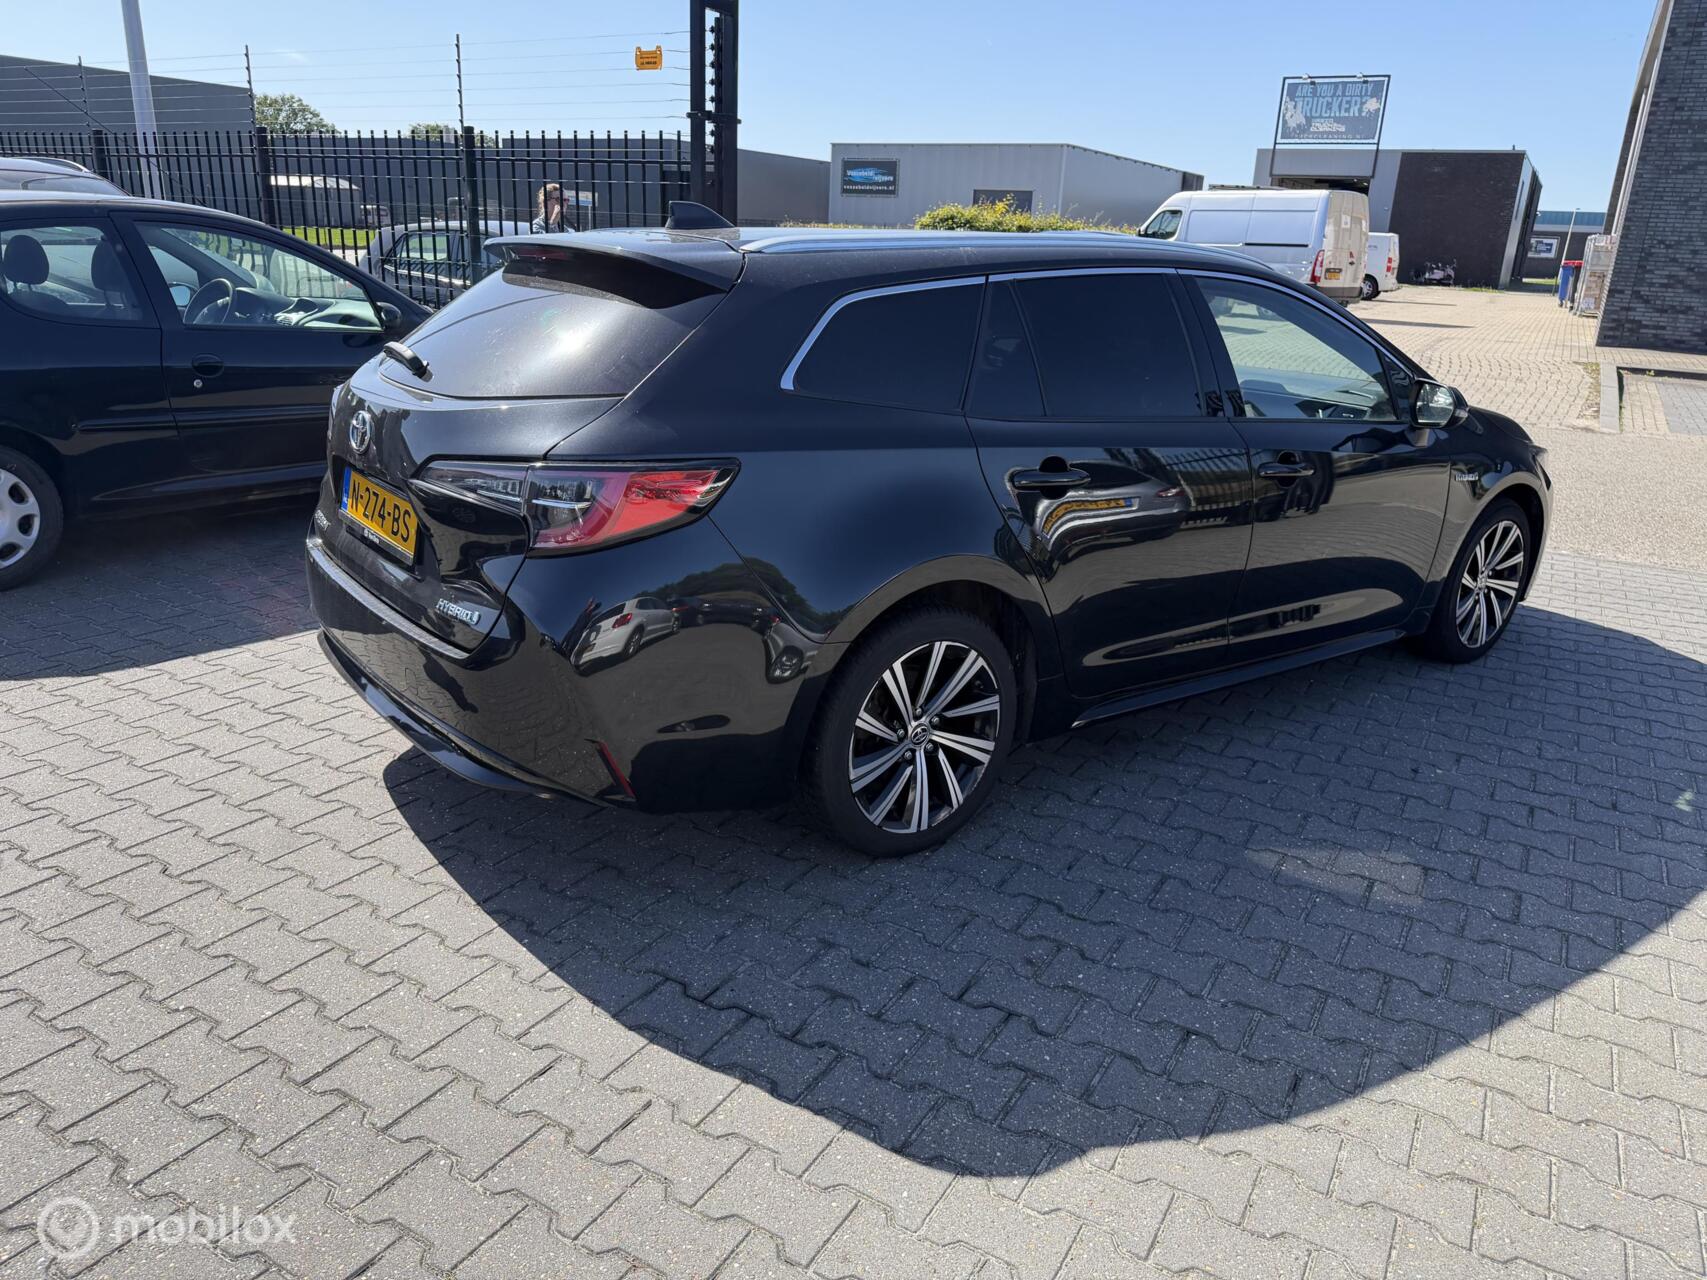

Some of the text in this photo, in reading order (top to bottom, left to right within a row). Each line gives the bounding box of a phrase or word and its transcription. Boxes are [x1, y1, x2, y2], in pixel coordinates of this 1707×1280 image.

[1296, 83, 1372, 96] ARE YOU A DIRTY
[351, 479, 411, 542] N-274-BS
